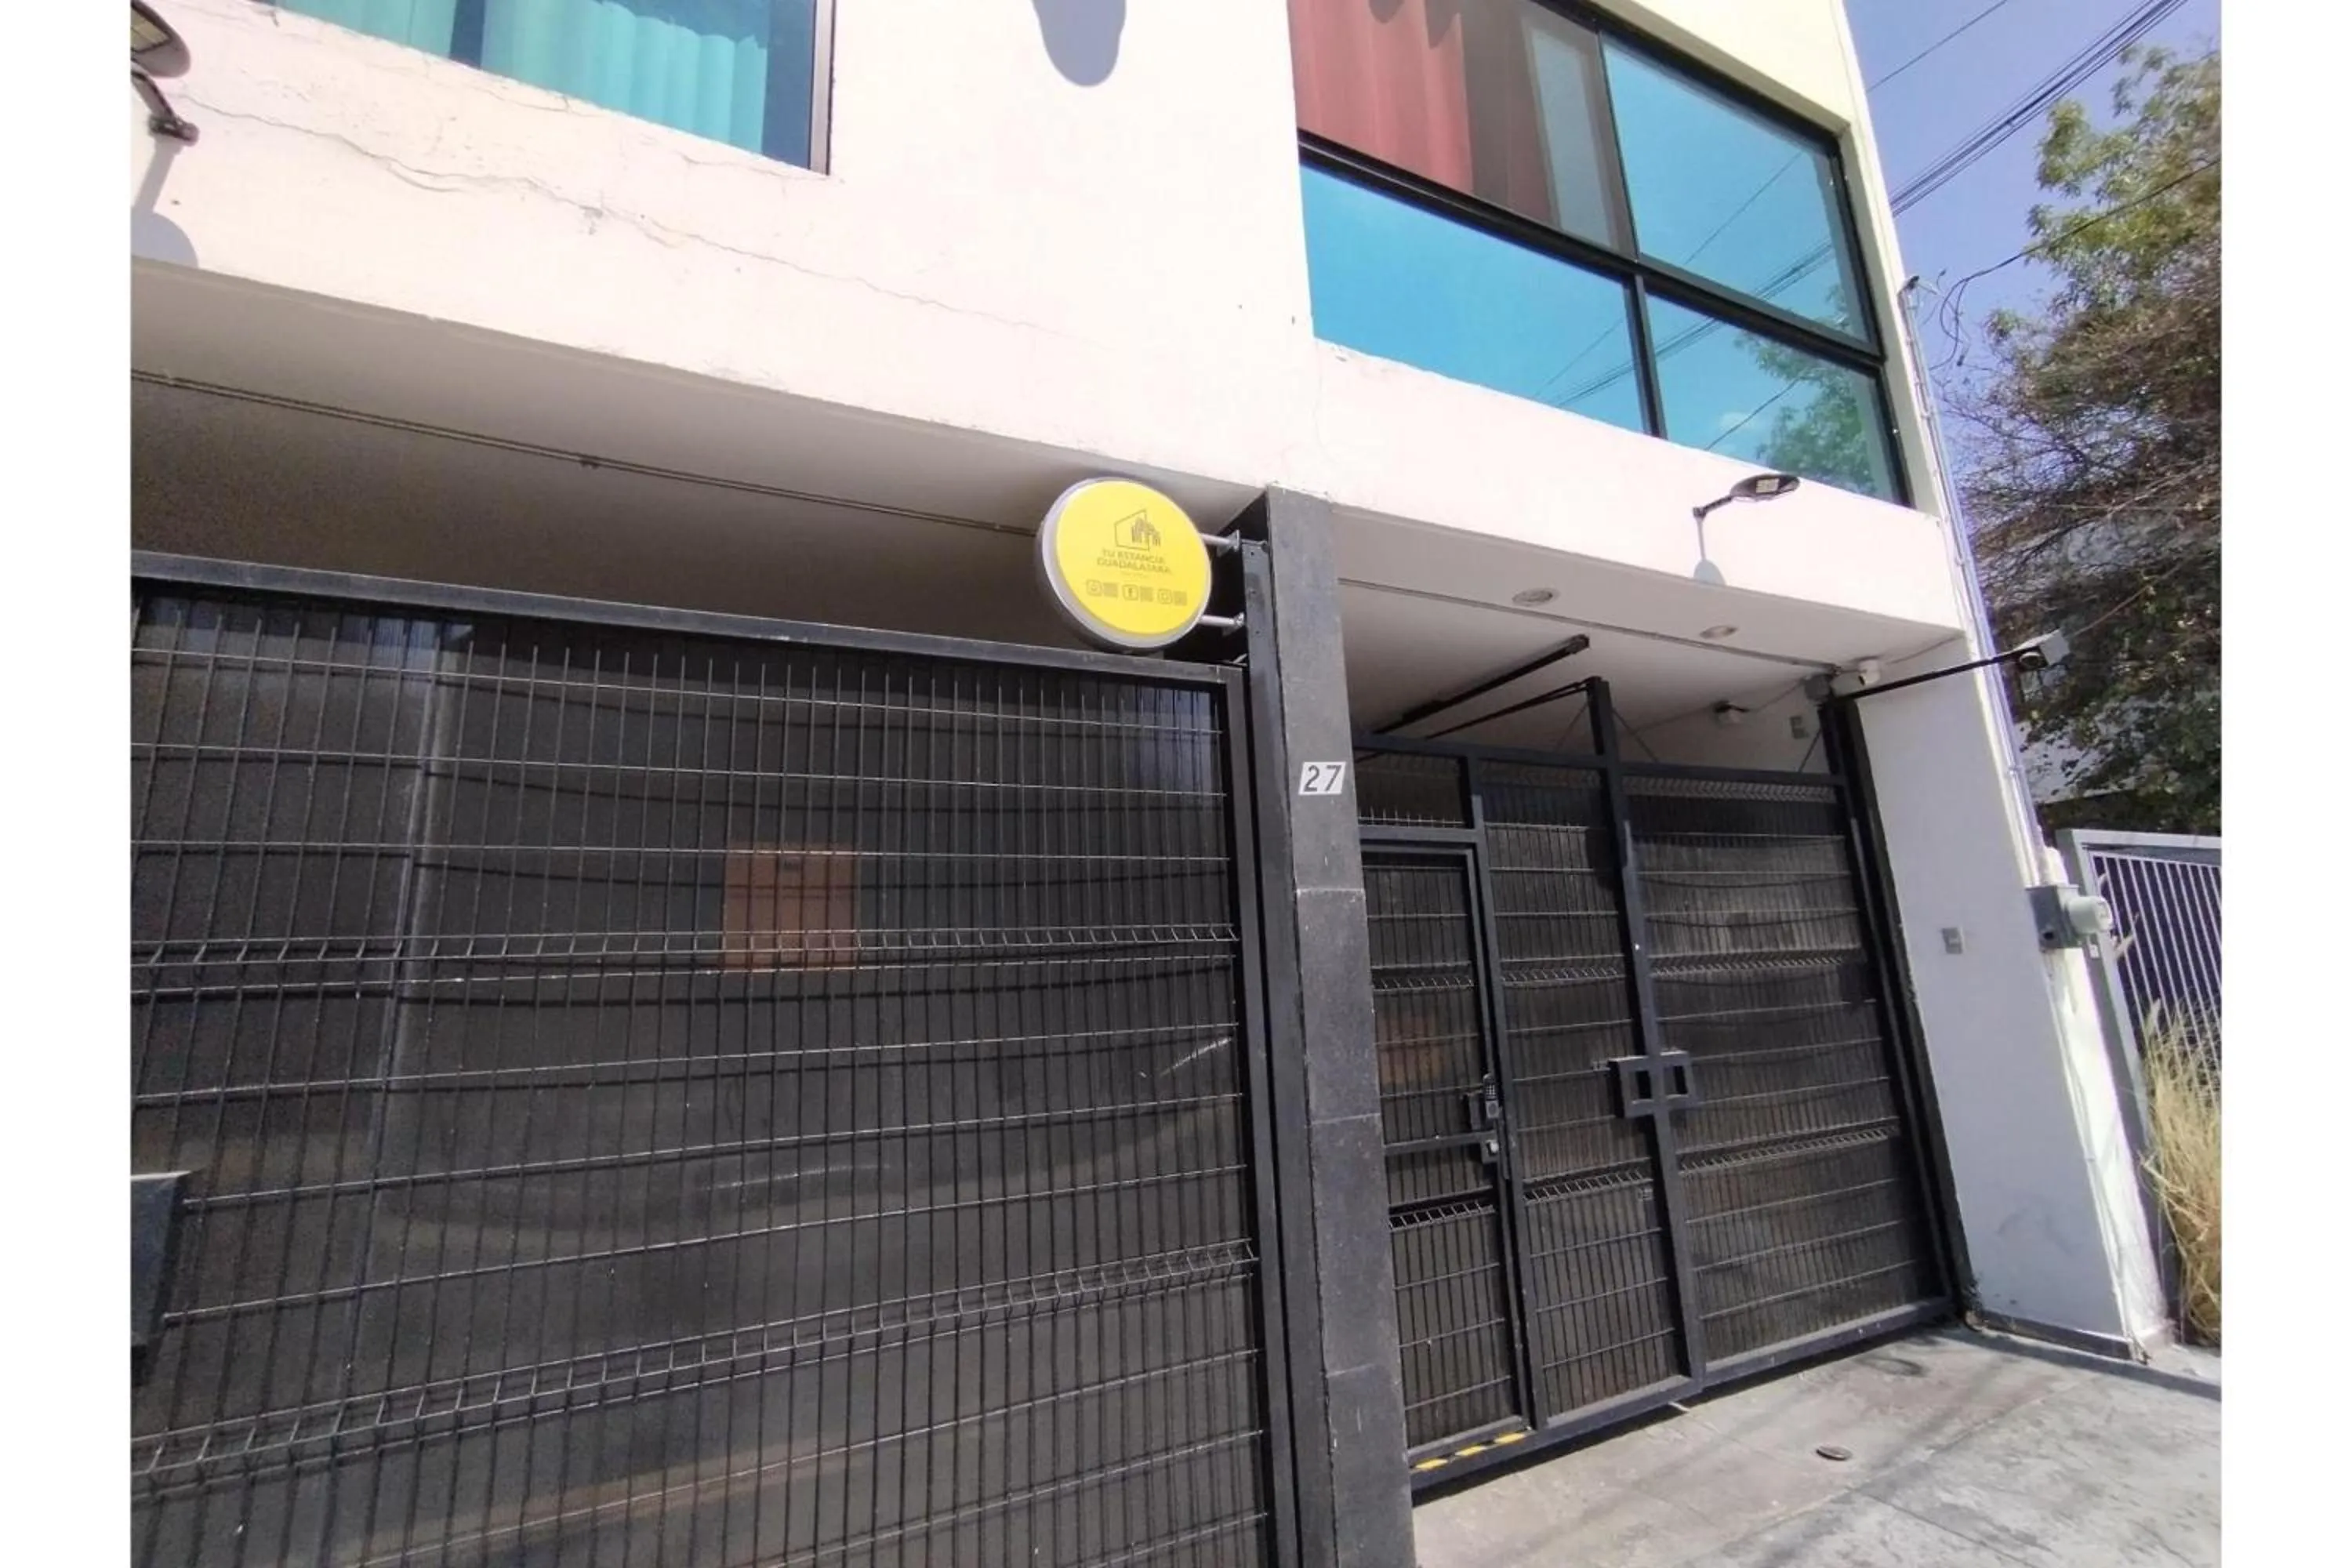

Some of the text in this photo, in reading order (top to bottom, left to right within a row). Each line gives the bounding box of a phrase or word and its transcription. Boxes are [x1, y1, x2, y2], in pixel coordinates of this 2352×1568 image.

[1102, 549, 1166, 564] TU ESTANCIA
[1304, 764, 1341, 792] 27
